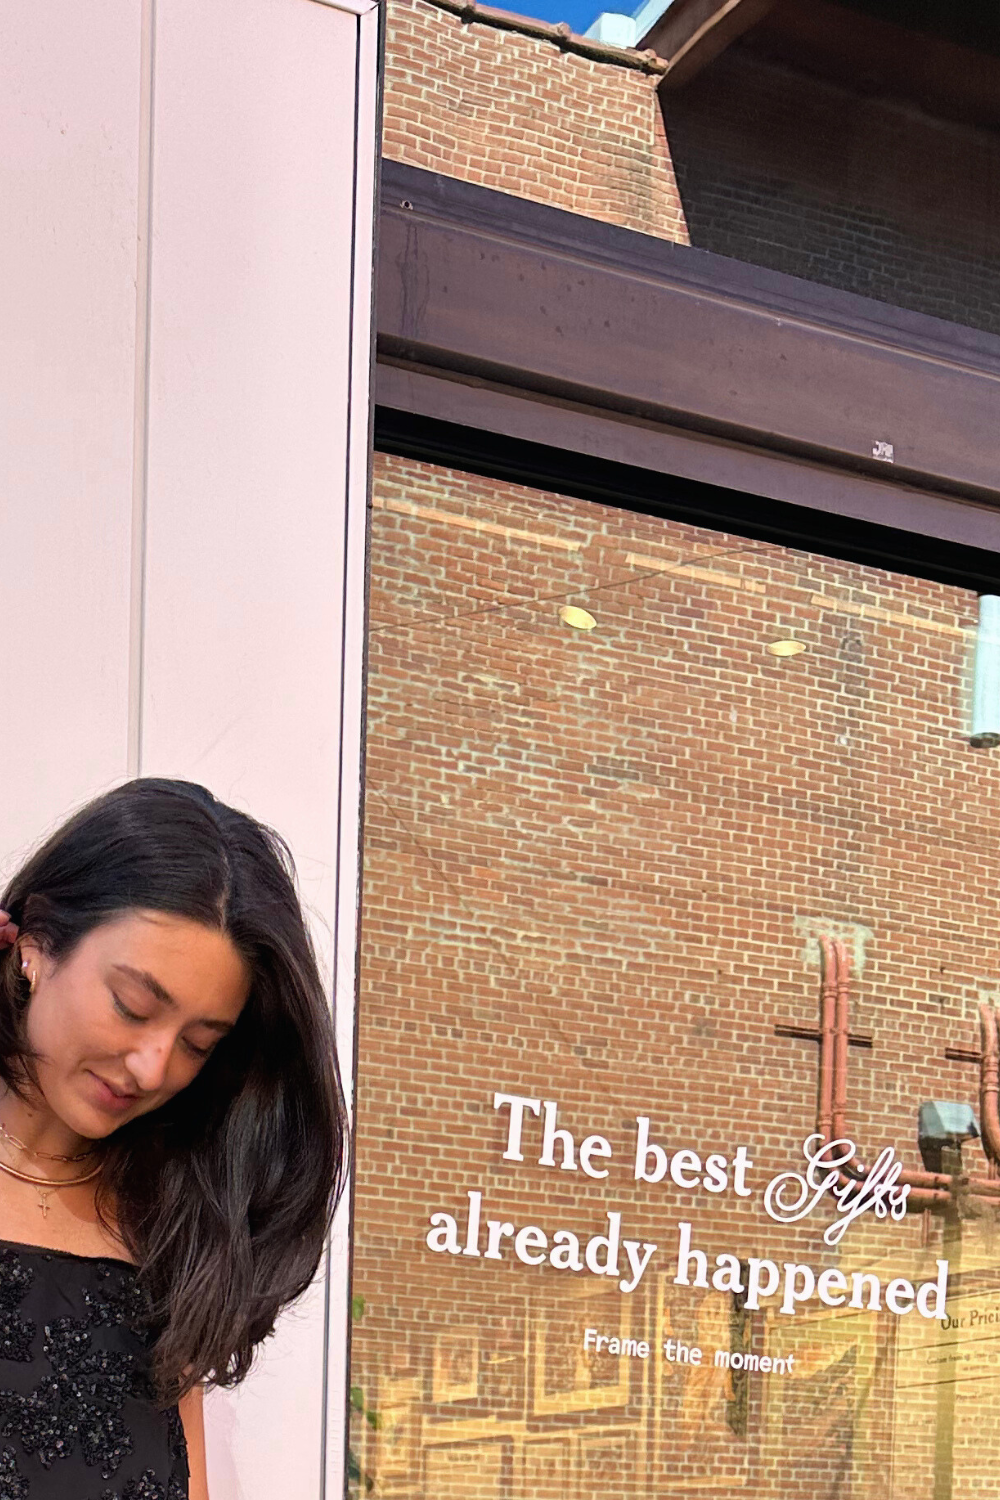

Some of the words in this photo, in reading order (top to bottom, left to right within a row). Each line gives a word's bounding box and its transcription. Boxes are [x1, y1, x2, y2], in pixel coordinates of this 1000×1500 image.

[494, 1092, 612, 1180] The
[634, 1116, 754, 1197] best
[764, 1133, 911, 1246] Gifts
[426, 1191, 658, 1293] already
[673, 1222, 949, 1320] happened
[583, 1328, 649, 1359] Frame
[663, 1338, 702, 1365] the
[714, 1350, 795, 1375] moment
[941, 1313, 966, 1330] Our
